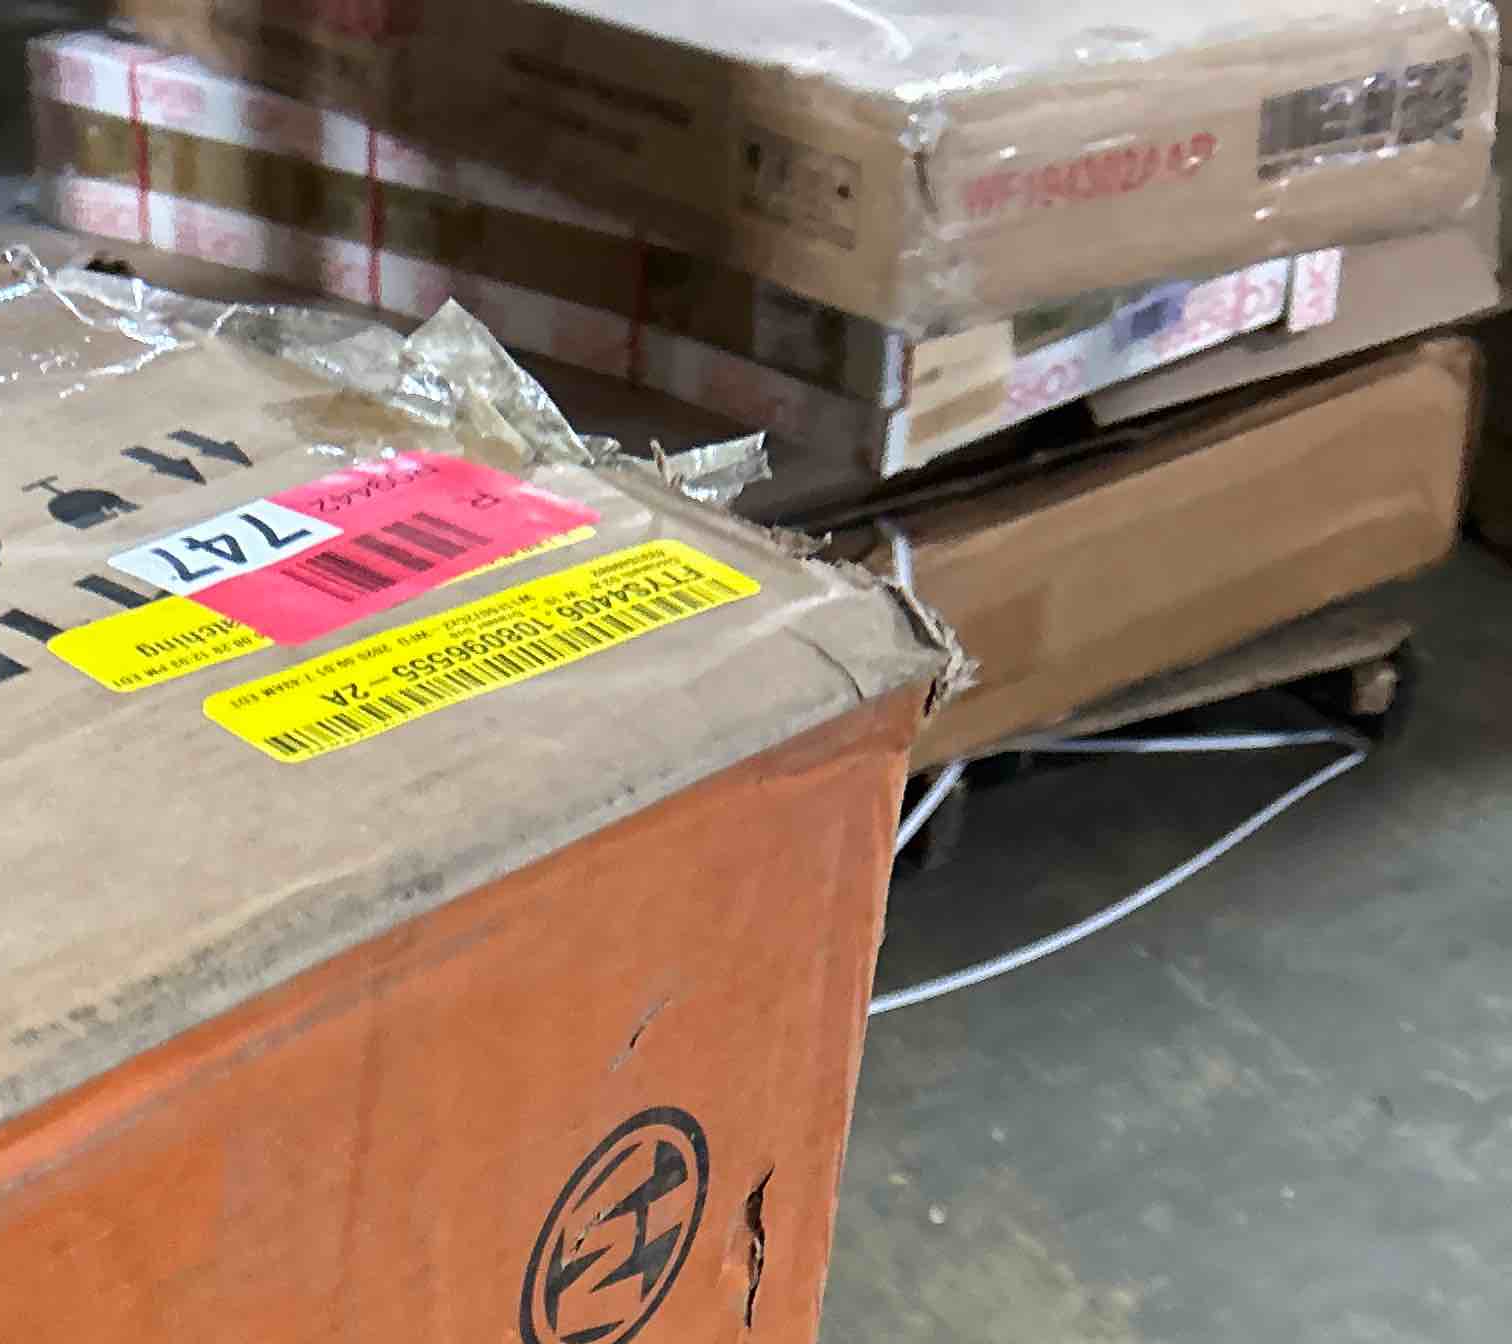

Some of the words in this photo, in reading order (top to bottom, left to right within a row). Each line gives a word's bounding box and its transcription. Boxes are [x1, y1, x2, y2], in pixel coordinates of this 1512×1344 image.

[149, 511, 314, 584] 747
[135, 618, 245, 658] atching
[320, 682, 371, 708] 2A
